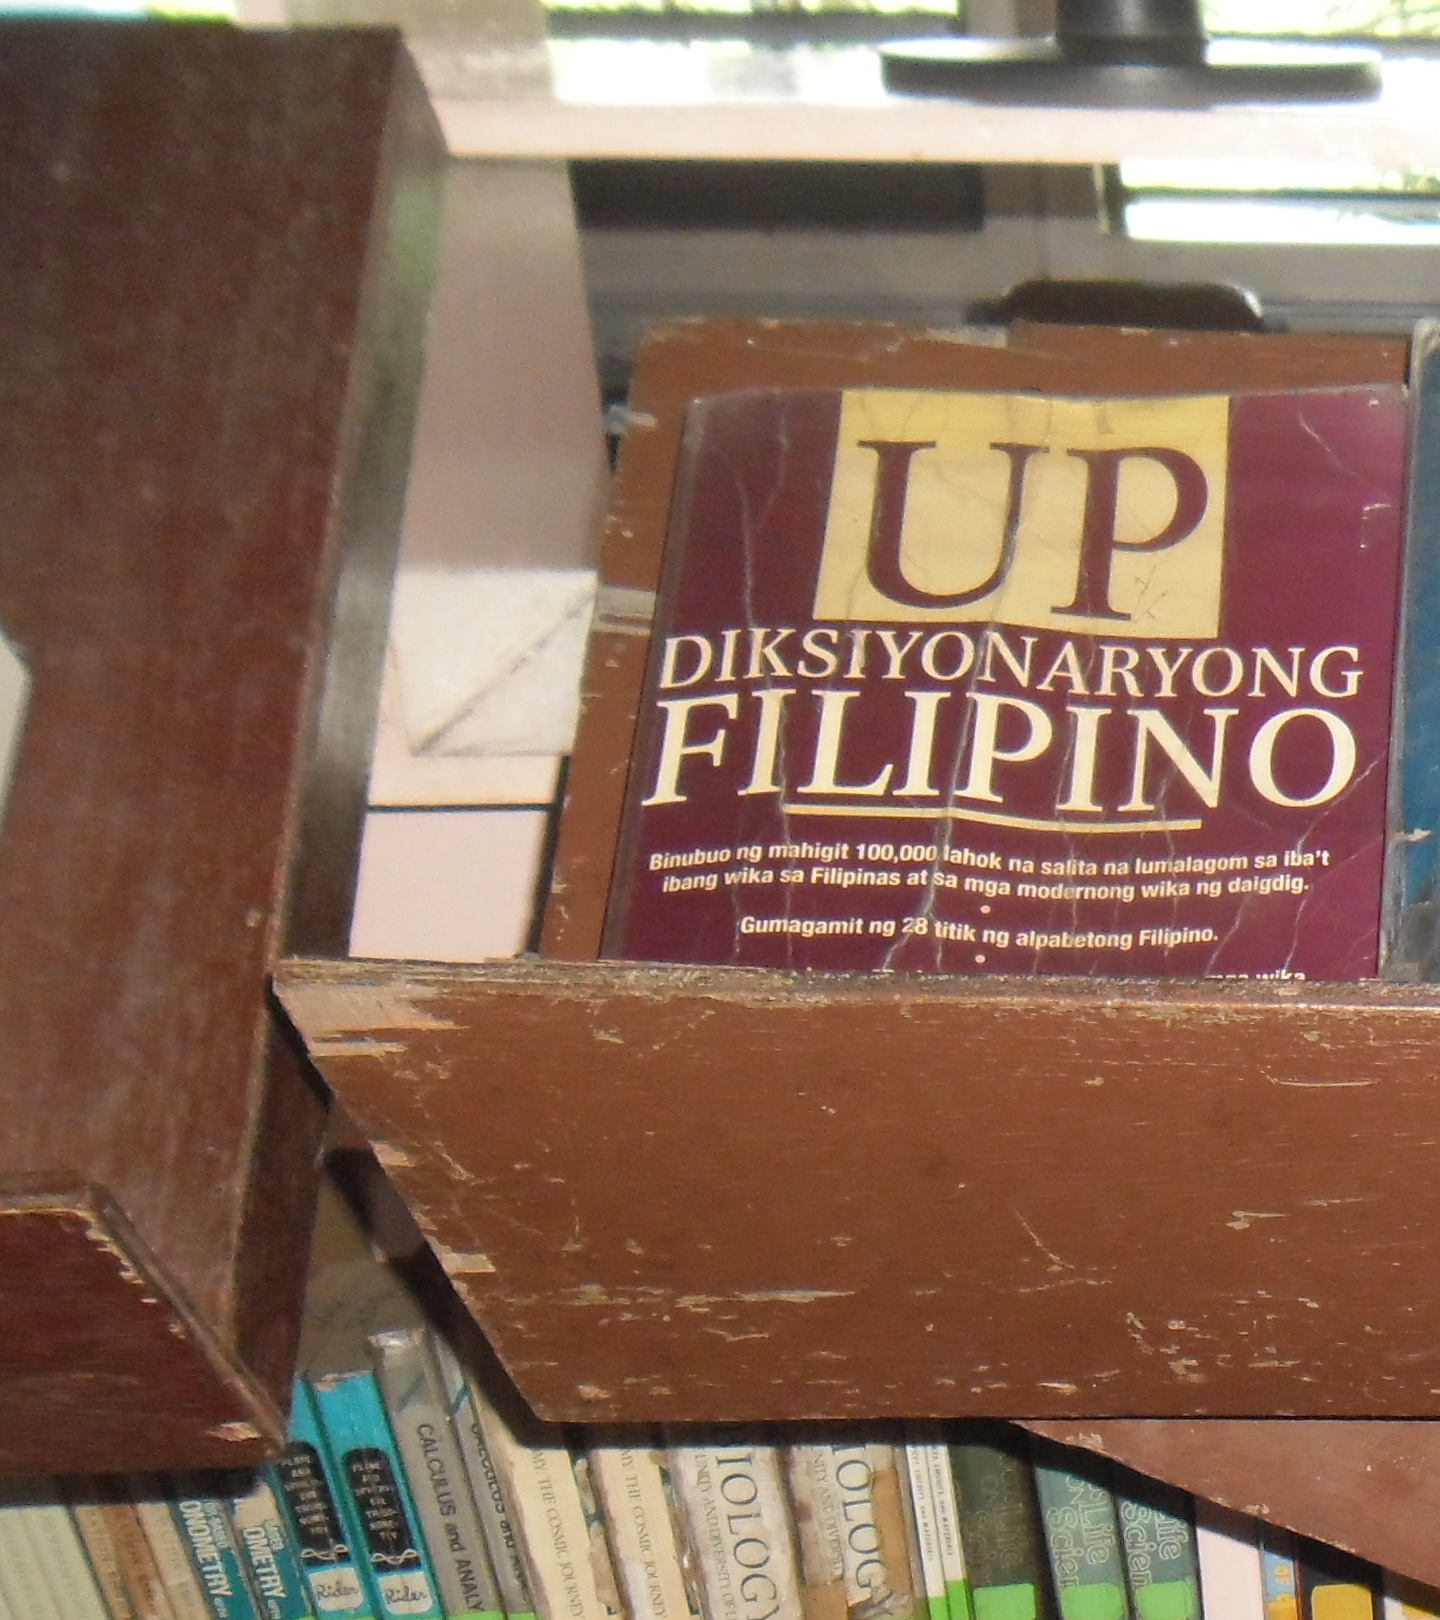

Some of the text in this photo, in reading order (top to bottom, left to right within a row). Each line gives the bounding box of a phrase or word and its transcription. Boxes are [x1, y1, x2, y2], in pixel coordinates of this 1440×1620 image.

[857, 438, 1210, 623] UP
[658, 626, 1364, 700] DIKSIYONARYONG
[641, 689, 1357, 813] FILIPINO
[649, 842, 1330, 876] Binubuo ng mahigit 100,000 lahok na salita na lumalagom sa iba't
[662, 867, 1310, 902] ibang wika sa Filipinas at sa mga modernong wika ng daigdig.
[740, 916, 1218, 951] Gumagamit ng 28 titik ng alpabetong Filipino.
[416, 1424, 465, 1552] CALCULUS and
[548, 1507, 587, 1620] COSMIC JOURNEY
[633, 1504, 668, 1618] COSMIC JOURNEY
